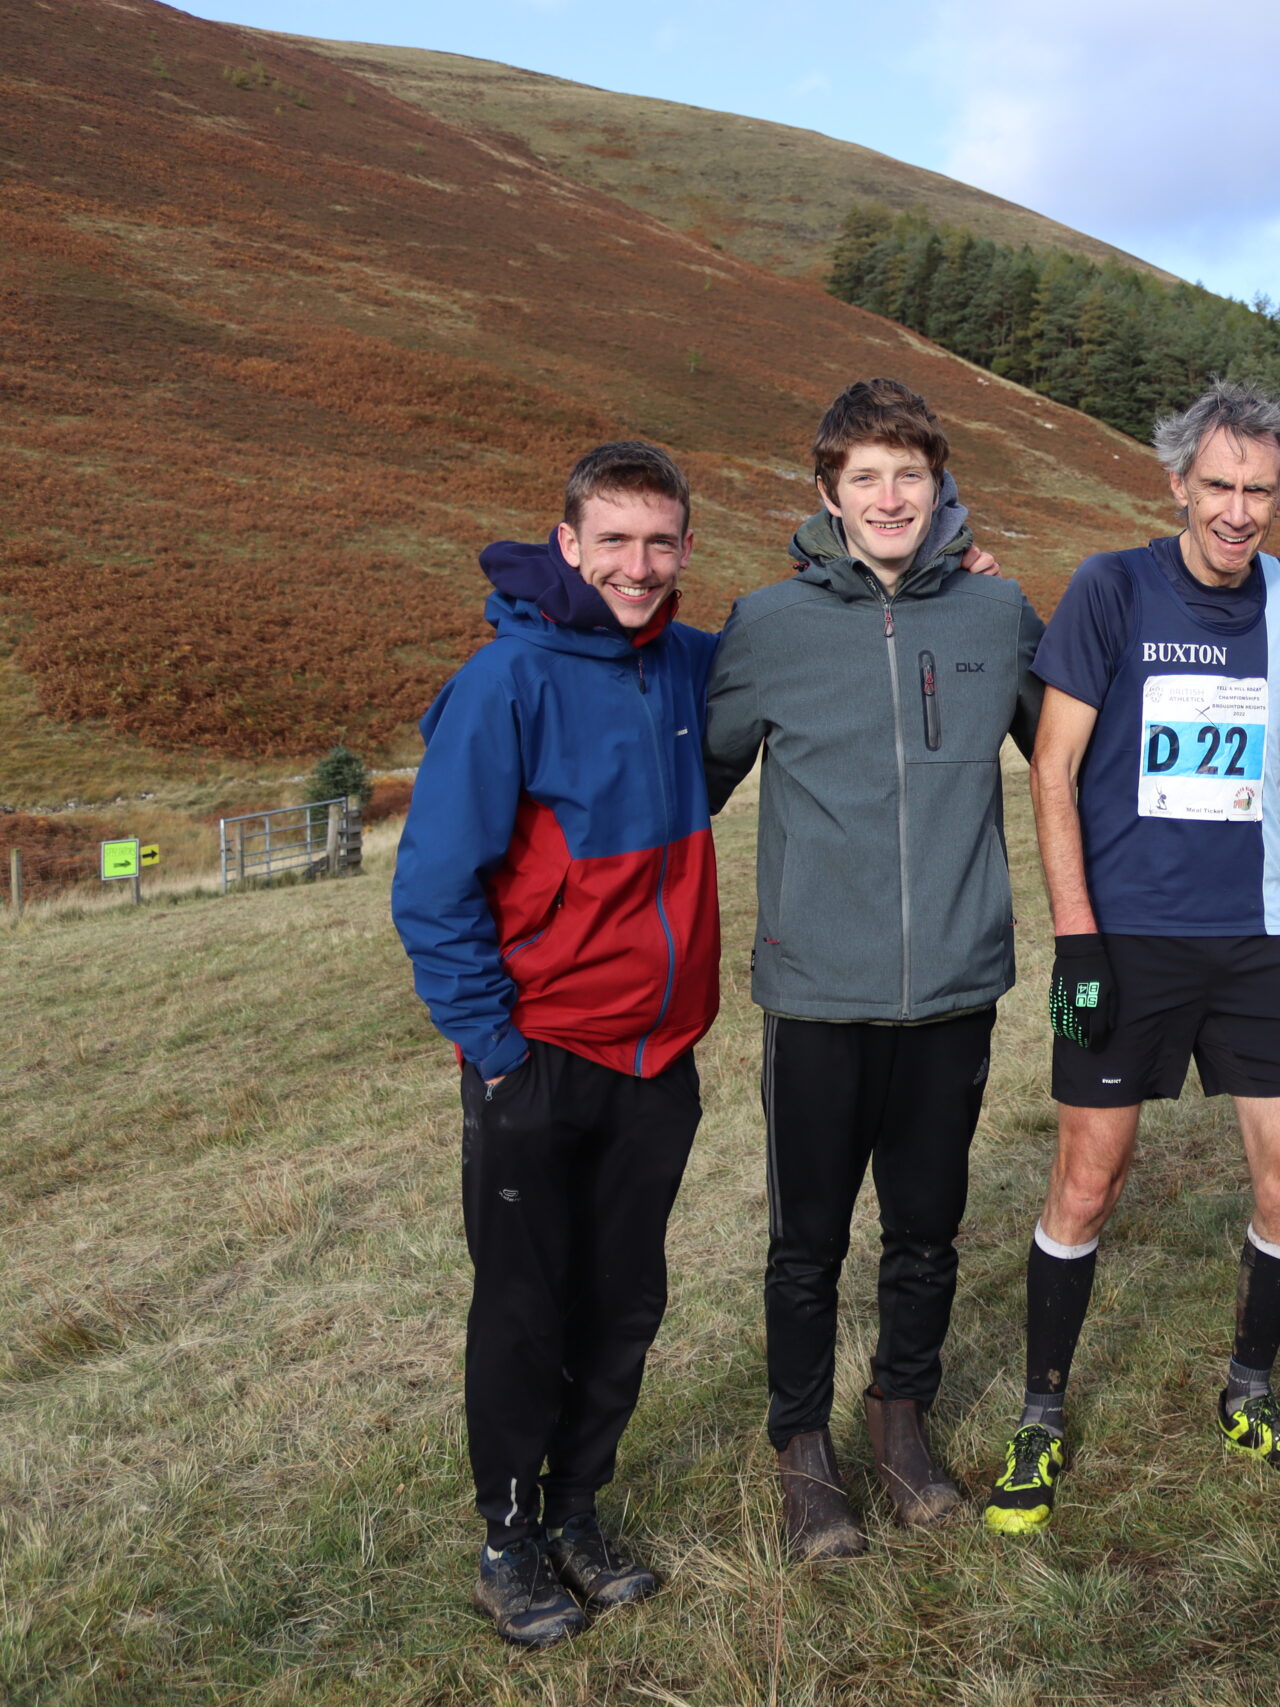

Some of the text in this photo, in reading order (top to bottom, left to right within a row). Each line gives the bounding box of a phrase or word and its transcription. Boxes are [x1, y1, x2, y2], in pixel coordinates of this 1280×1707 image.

[1142, 642, 1228, 666] BUXTON
[955, 662, 985, 673] DLX
[1147, 724, 1248, 776] D 22
